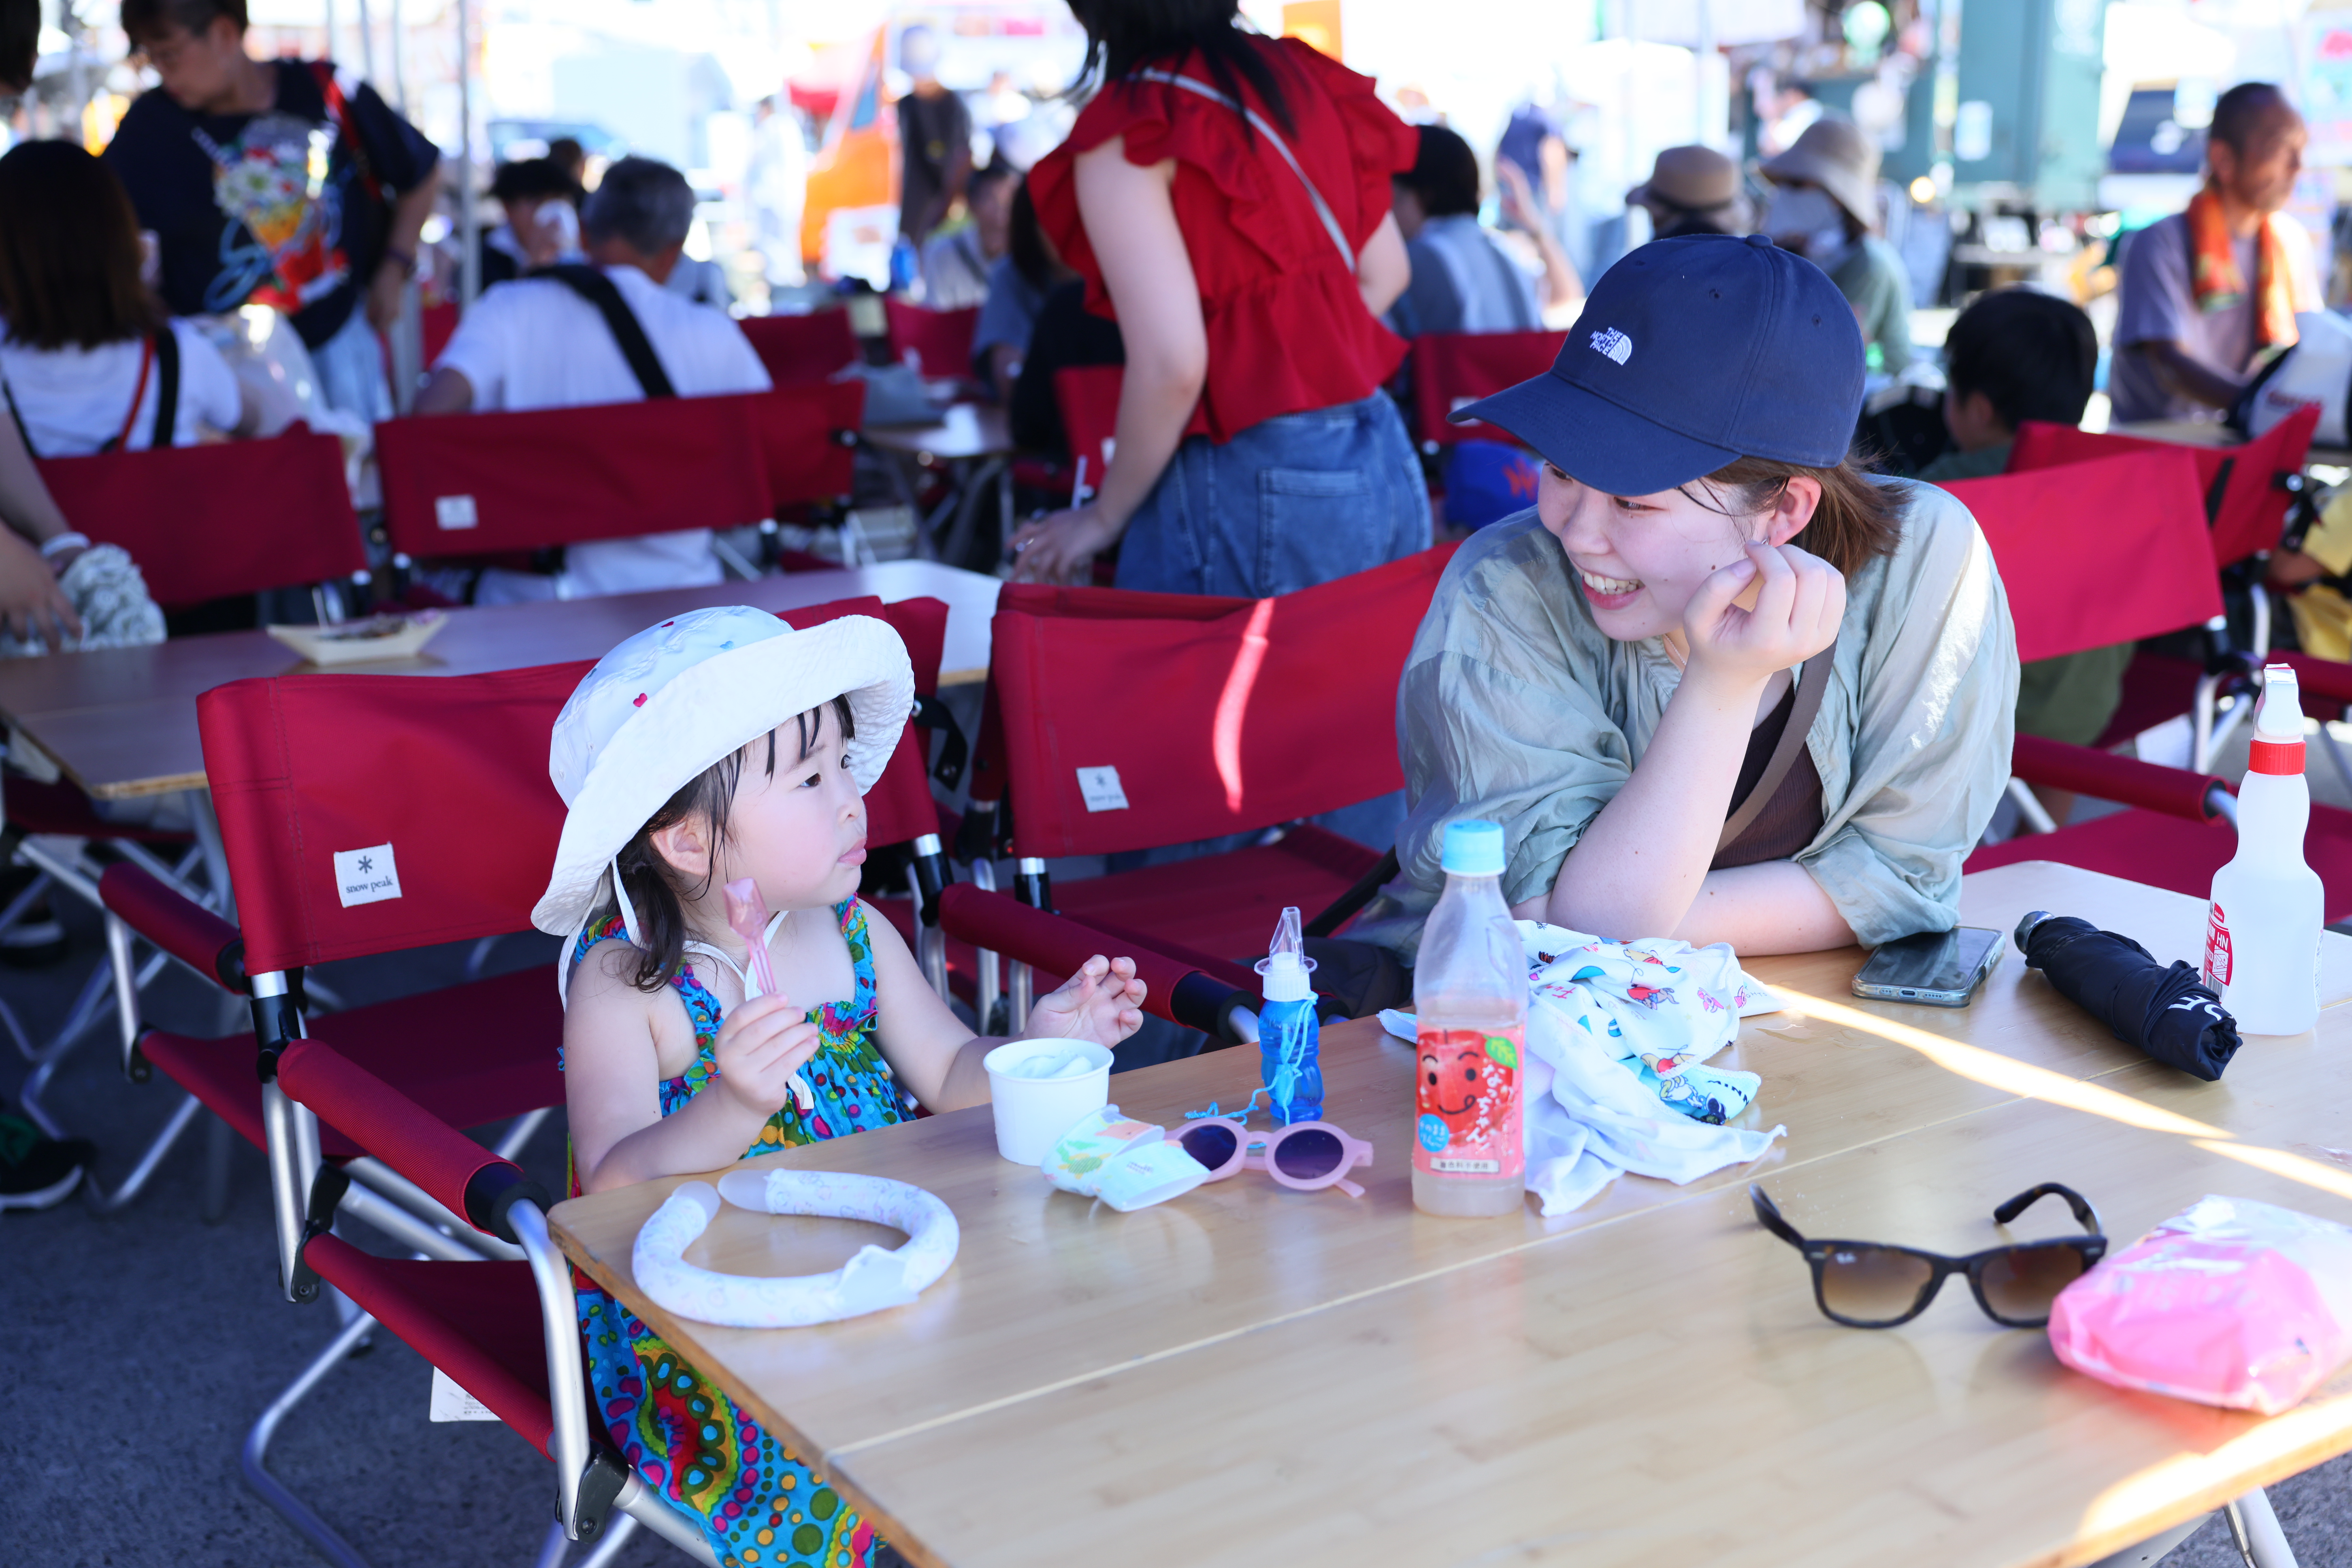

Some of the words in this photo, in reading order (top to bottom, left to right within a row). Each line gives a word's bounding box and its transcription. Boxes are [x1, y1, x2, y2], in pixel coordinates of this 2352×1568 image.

[1590, 330, 1618, 349] NORTH
[1606, 326, 1623, 341] THE
[1589, 339, 1613, 356] FACE
[346, 883, 368, 893] snow
[371, 876, 393, 892] peak
[2214, 910, 2223, 920] SARAYA
[2216, 932, 2229, 951] HN
